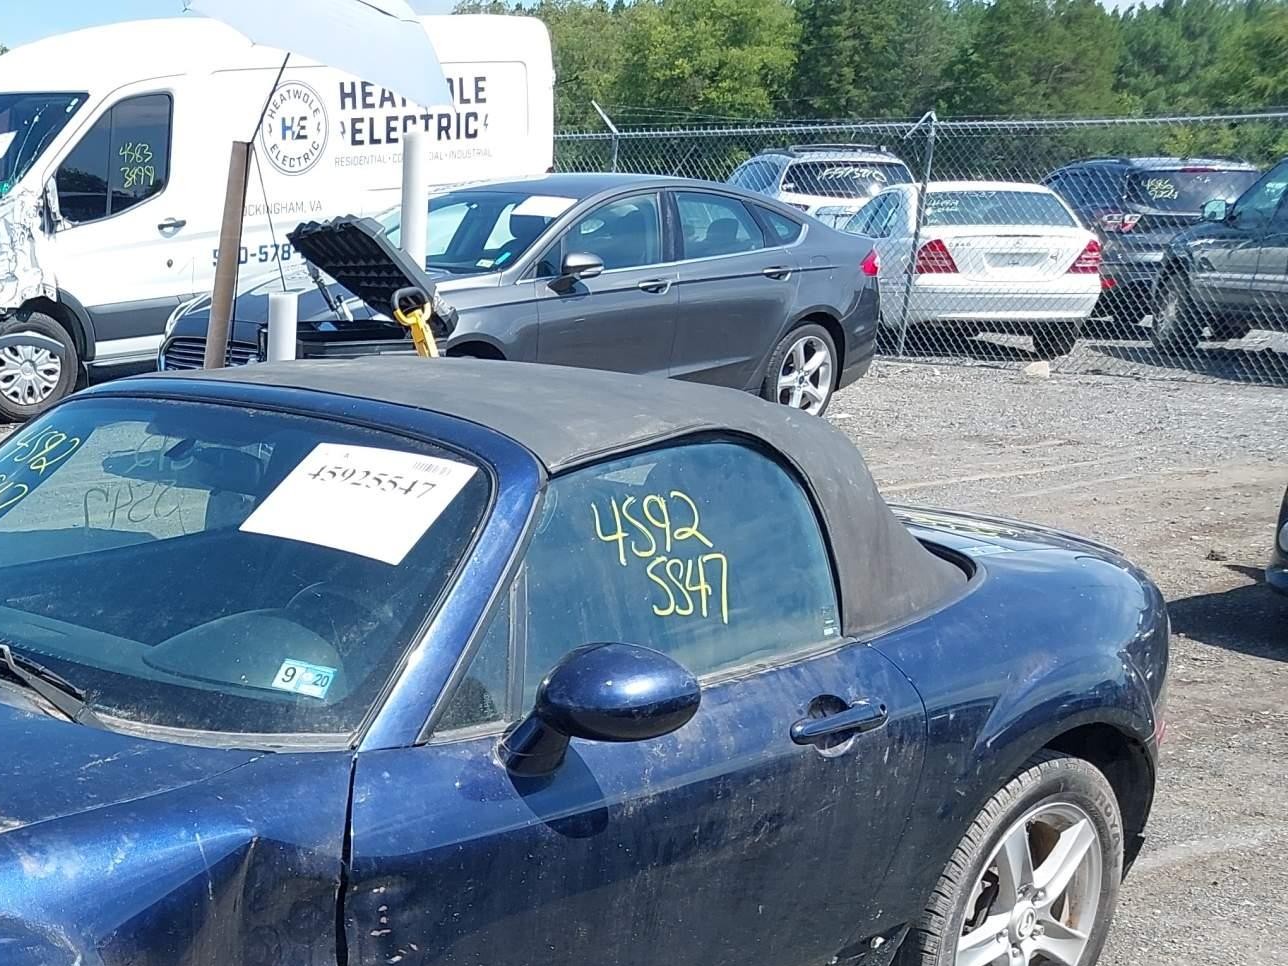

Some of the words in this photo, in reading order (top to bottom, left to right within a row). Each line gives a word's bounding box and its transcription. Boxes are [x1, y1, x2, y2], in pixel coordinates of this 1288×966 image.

[268, 88, 321, 120] HEATWOLE
[339, 77, 487, 110] HEALE
[269, 140, 320, 168] ELECTRIC
[334, 154, 388, 168] RESIDENTIAL
[242, 200, 307, 217] OCKINGHAM,
[309, 200, 323, 212] VA
[308, 465, 437, 499] 45925547
[591, 490, 714, 566] 4592
[281, 666, 297, 683] 9
[312, 673, 330, 687] 20
